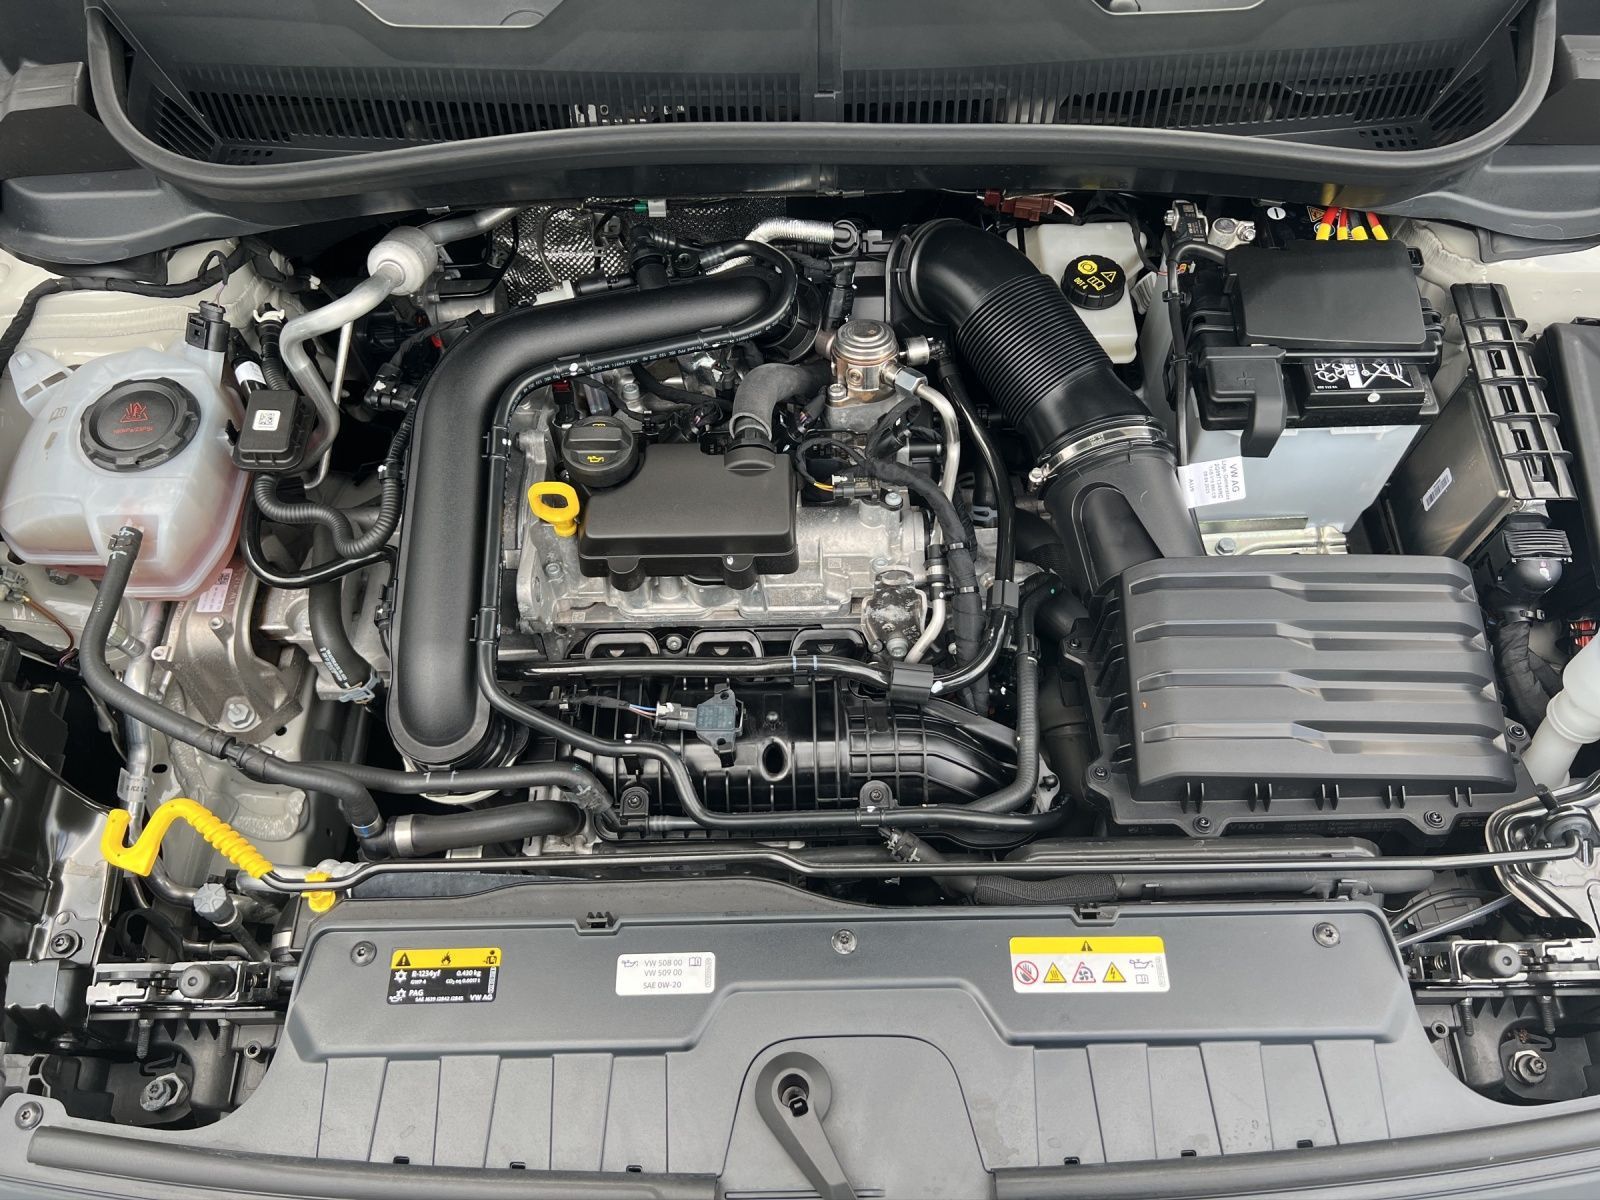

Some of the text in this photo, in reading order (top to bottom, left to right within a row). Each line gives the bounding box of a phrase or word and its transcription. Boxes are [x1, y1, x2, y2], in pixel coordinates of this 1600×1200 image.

[1230, 464, 1240, 492] VW AG
[412, 969, 441, 978] R-1234yf
[473, 970, 482, 978] kg
[657, 981, 682, 989] 0W-20
